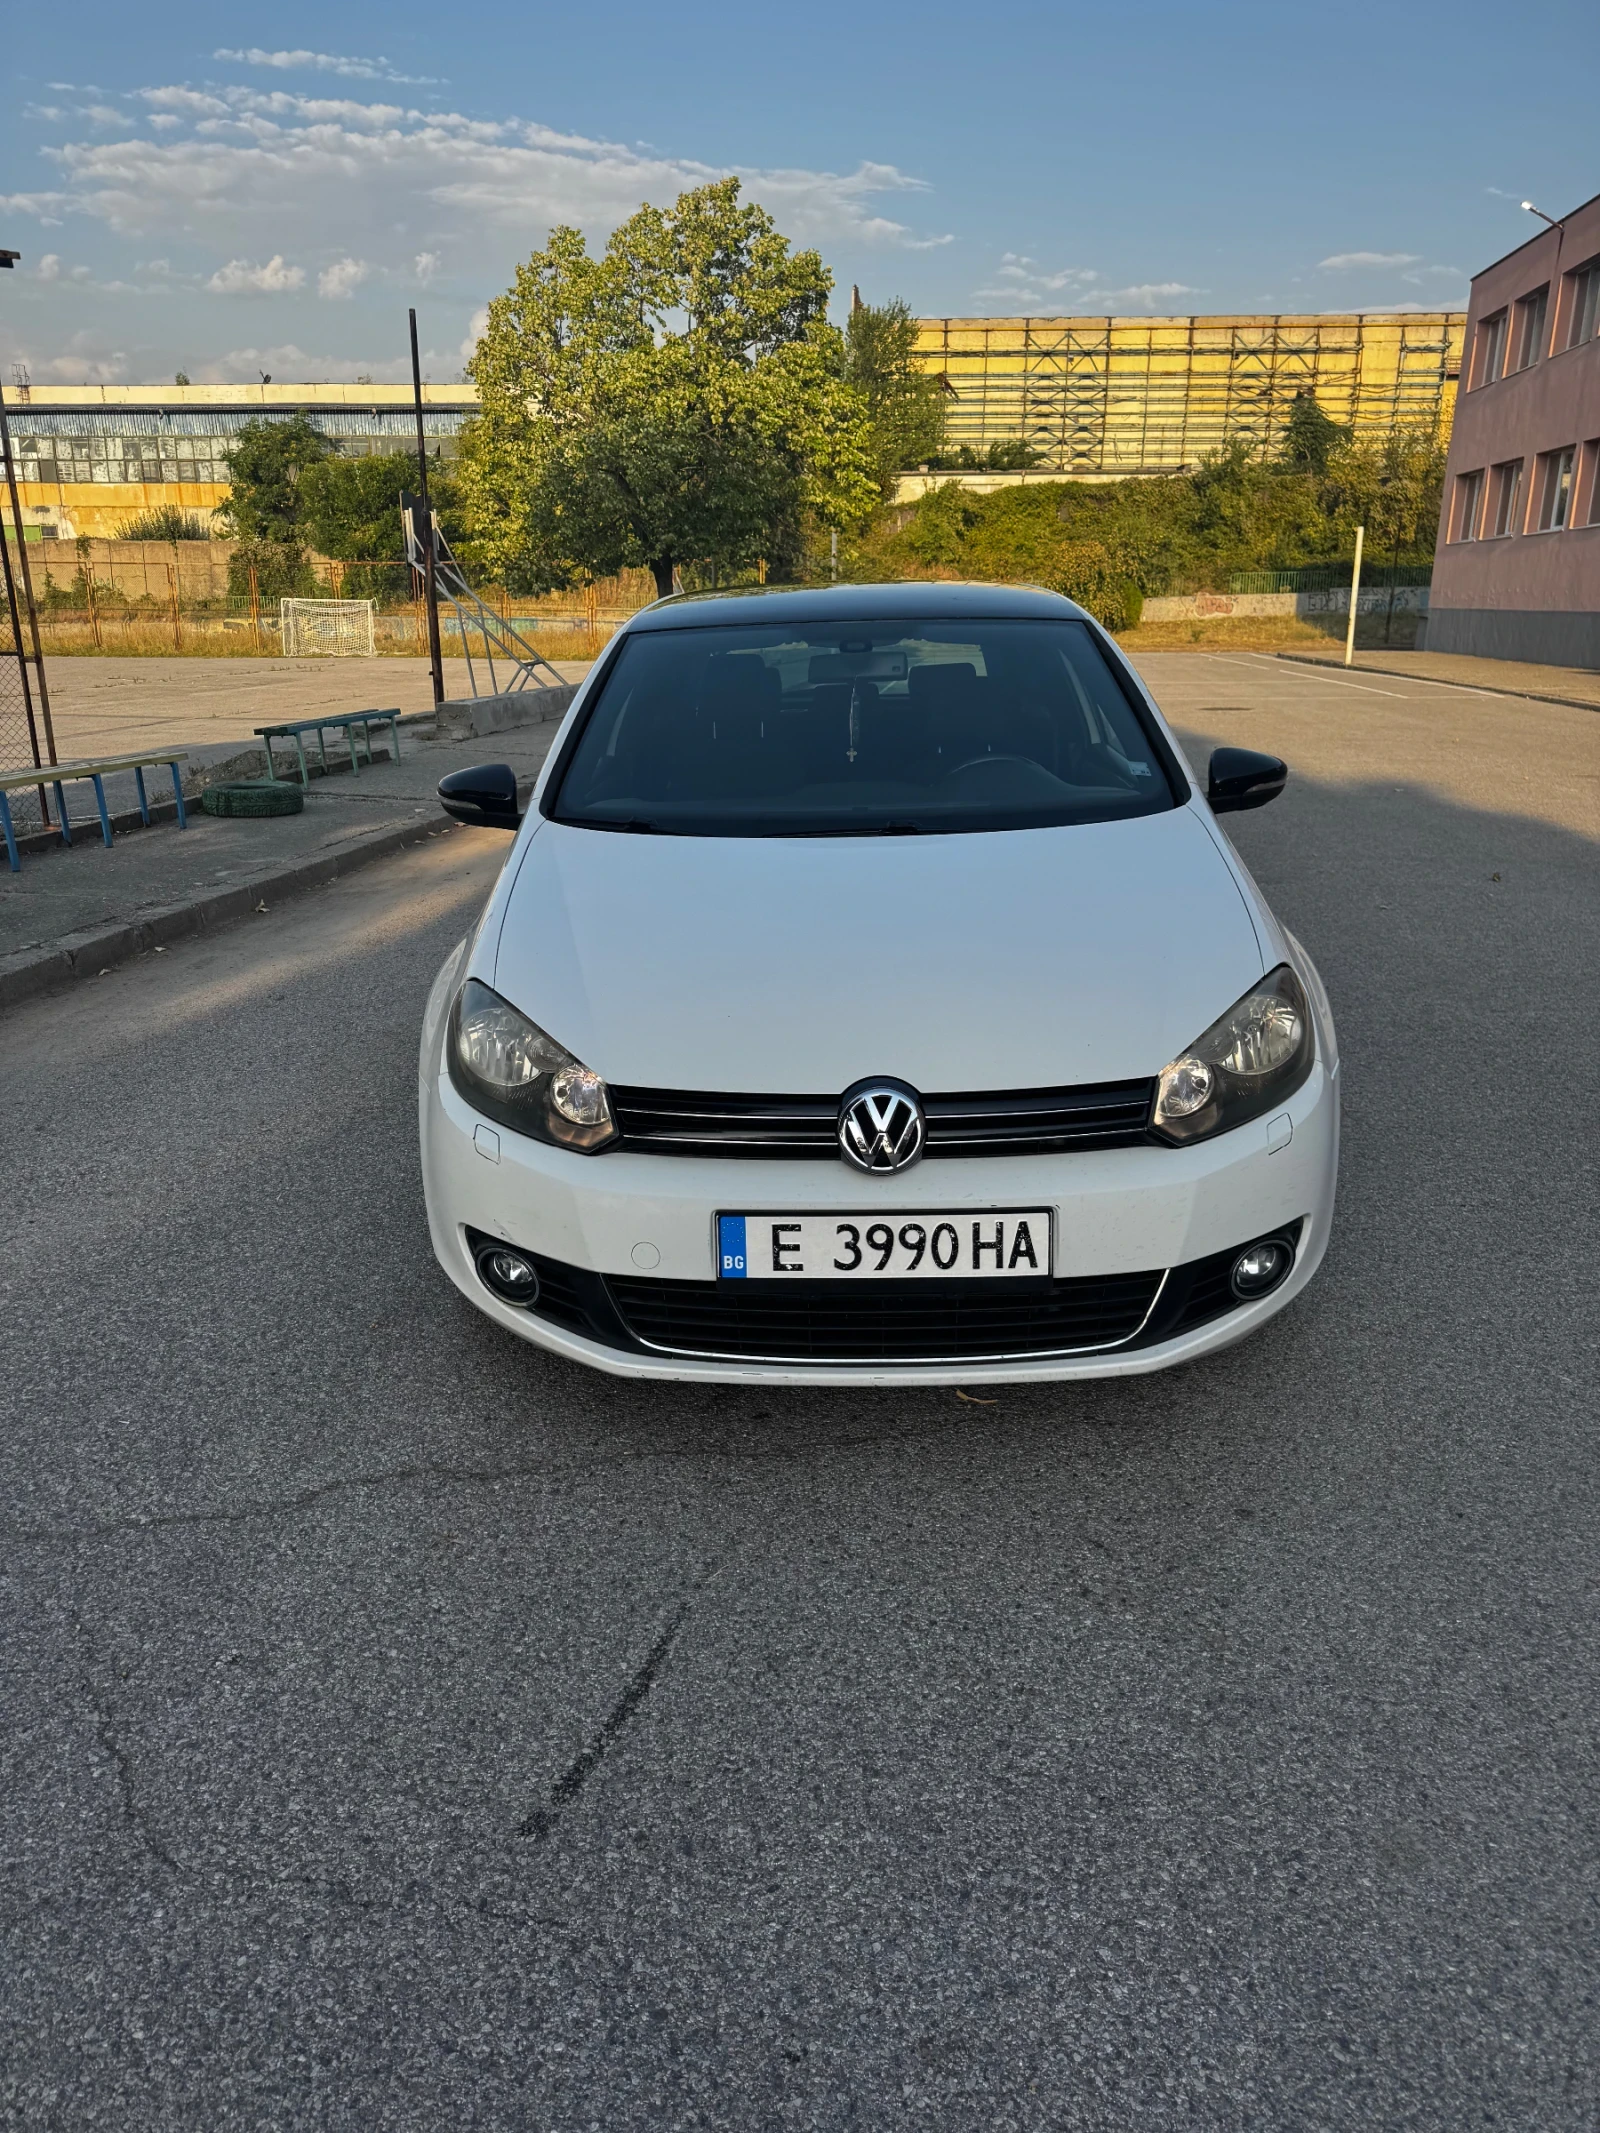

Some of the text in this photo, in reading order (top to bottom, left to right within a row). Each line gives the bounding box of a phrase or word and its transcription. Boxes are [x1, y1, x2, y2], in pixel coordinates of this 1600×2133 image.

[843, 1090, 921, 1170] VW
[723, 1255, 744, 1270] BG
[771, 1224, 804, 1272] E
[833, 1222, 959, 1271] 3990
